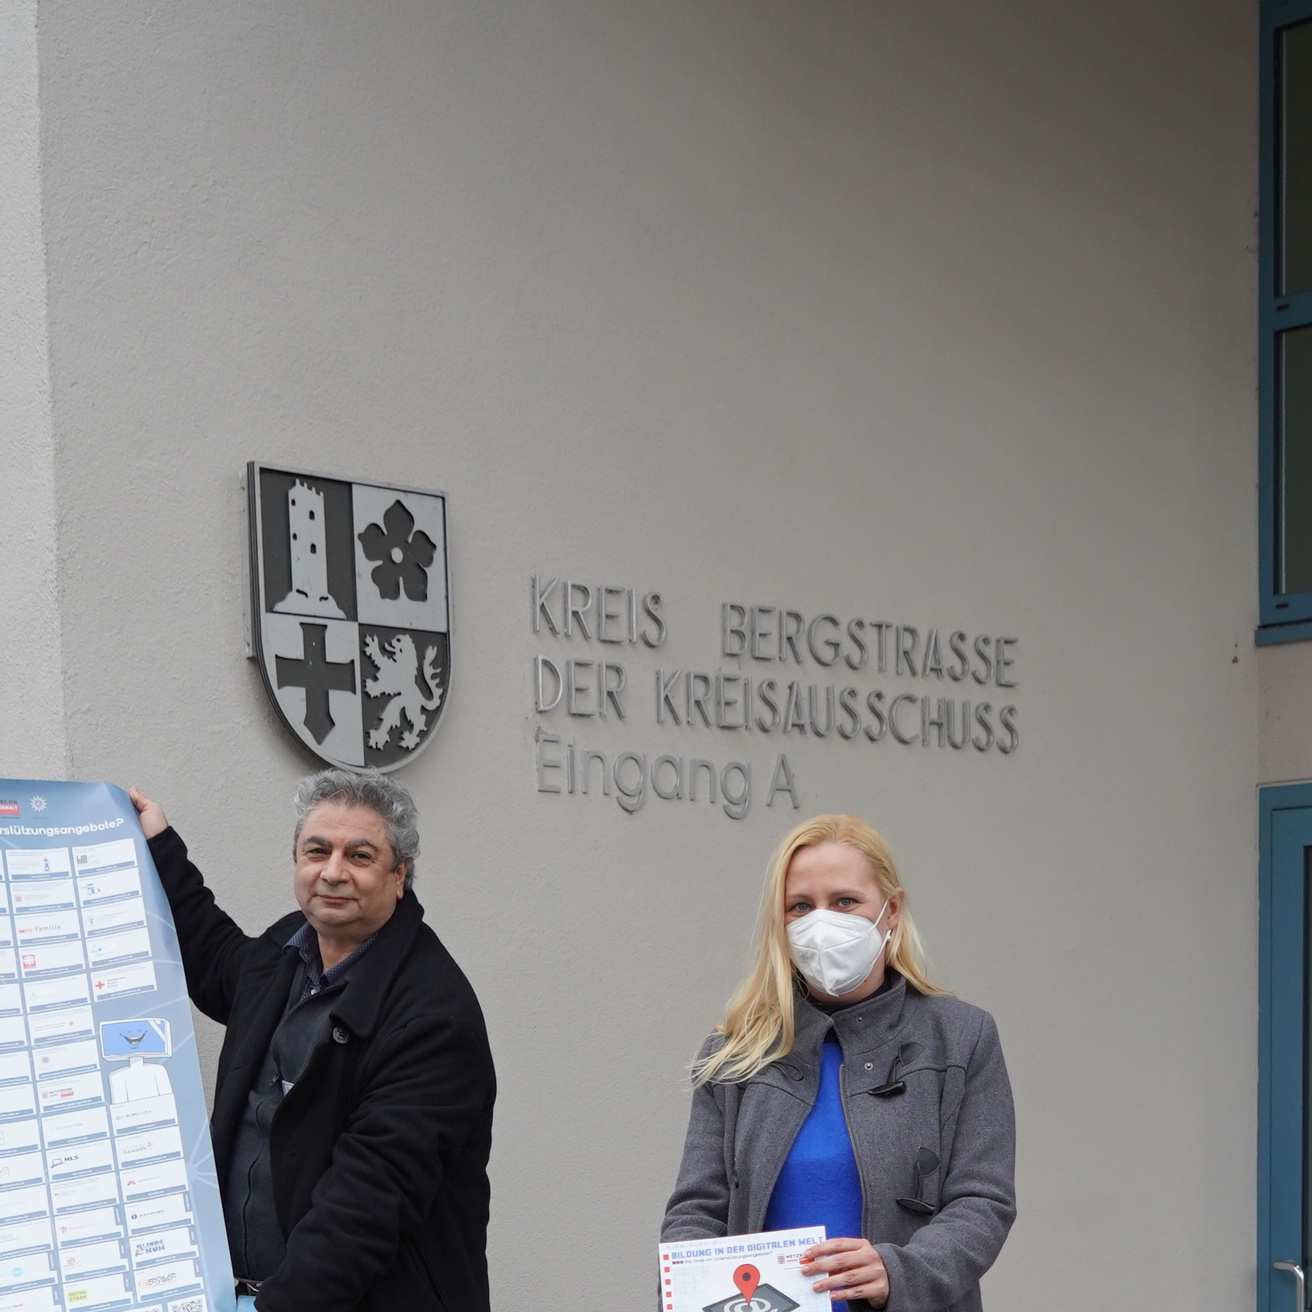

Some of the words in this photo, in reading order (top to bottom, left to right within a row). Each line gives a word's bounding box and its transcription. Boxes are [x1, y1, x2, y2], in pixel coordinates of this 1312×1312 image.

[530, 575, 668, 649] KREIS
[721, 602, 1020, 689] BERGSTRASSE
[534, 654, 627, 720] DER
[655, 668, 1020, 755] KREISAUSSCHUSS
[535, 726, 752, 820] Eingang
[766, 753, 801, 810] A
[671, 1248, 712, 1259] BILDUNG
[714, 1247, 724, 1255] IN
[726, 1244, 745, 1254] DER
[747, 1240, 796, 1252] DIGITALEN
